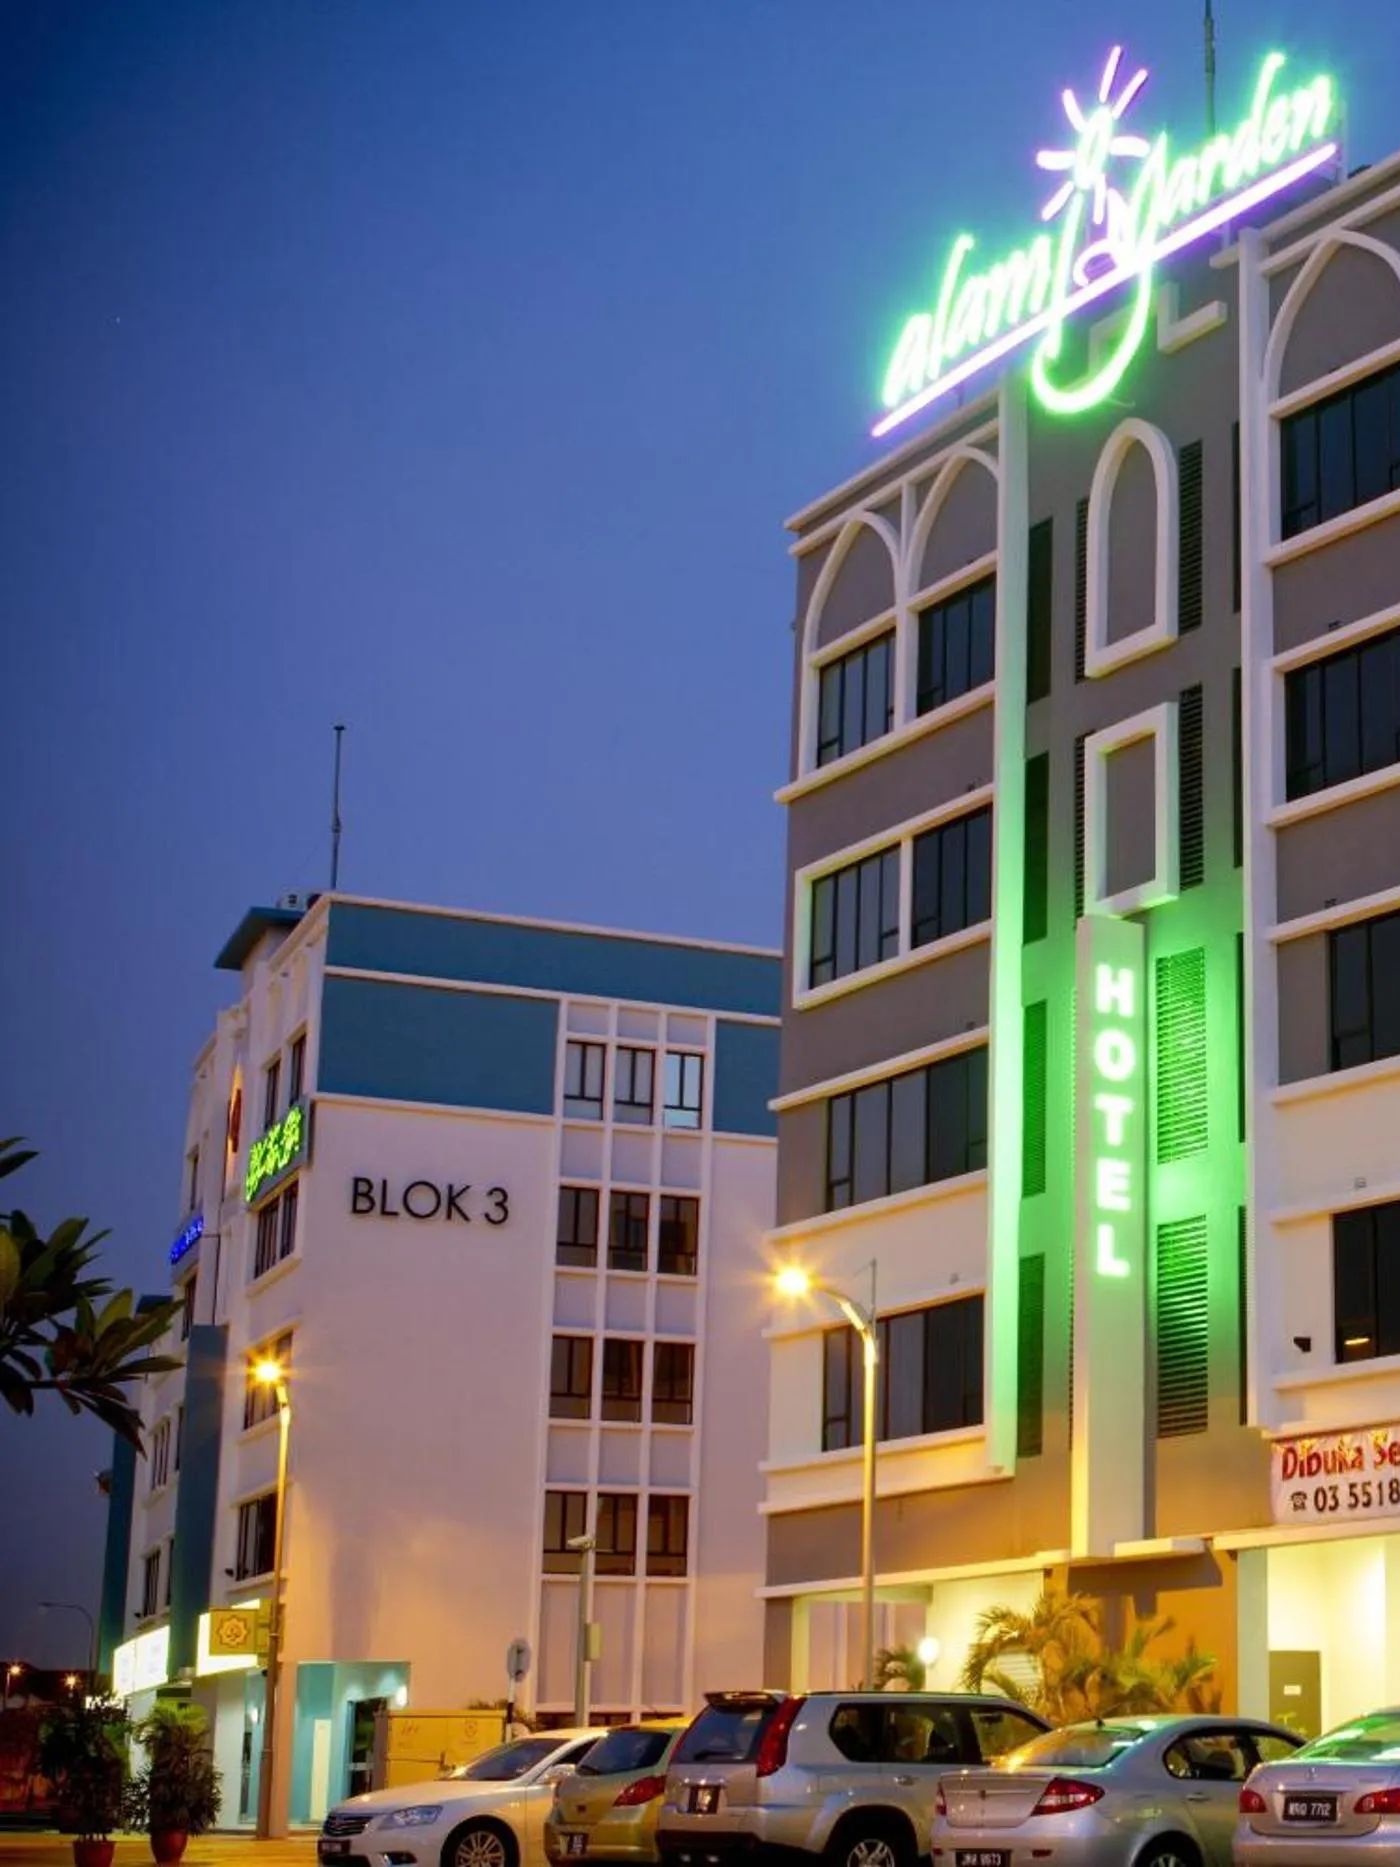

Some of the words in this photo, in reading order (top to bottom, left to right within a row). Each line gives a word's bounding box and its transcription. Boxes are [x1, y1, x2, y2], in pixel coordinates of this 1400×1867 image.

[1094, 963, 1136, 1278] HOTEL
[351, 1177, 472, 1222] BLOK
[484, 1187, 509, 1225] 3
[1281, 1439, 1364, 1481] Dibuka
[1313, 1485, 1339, 1513] 03
[1349, 1478, 1400, 1509] 5518
